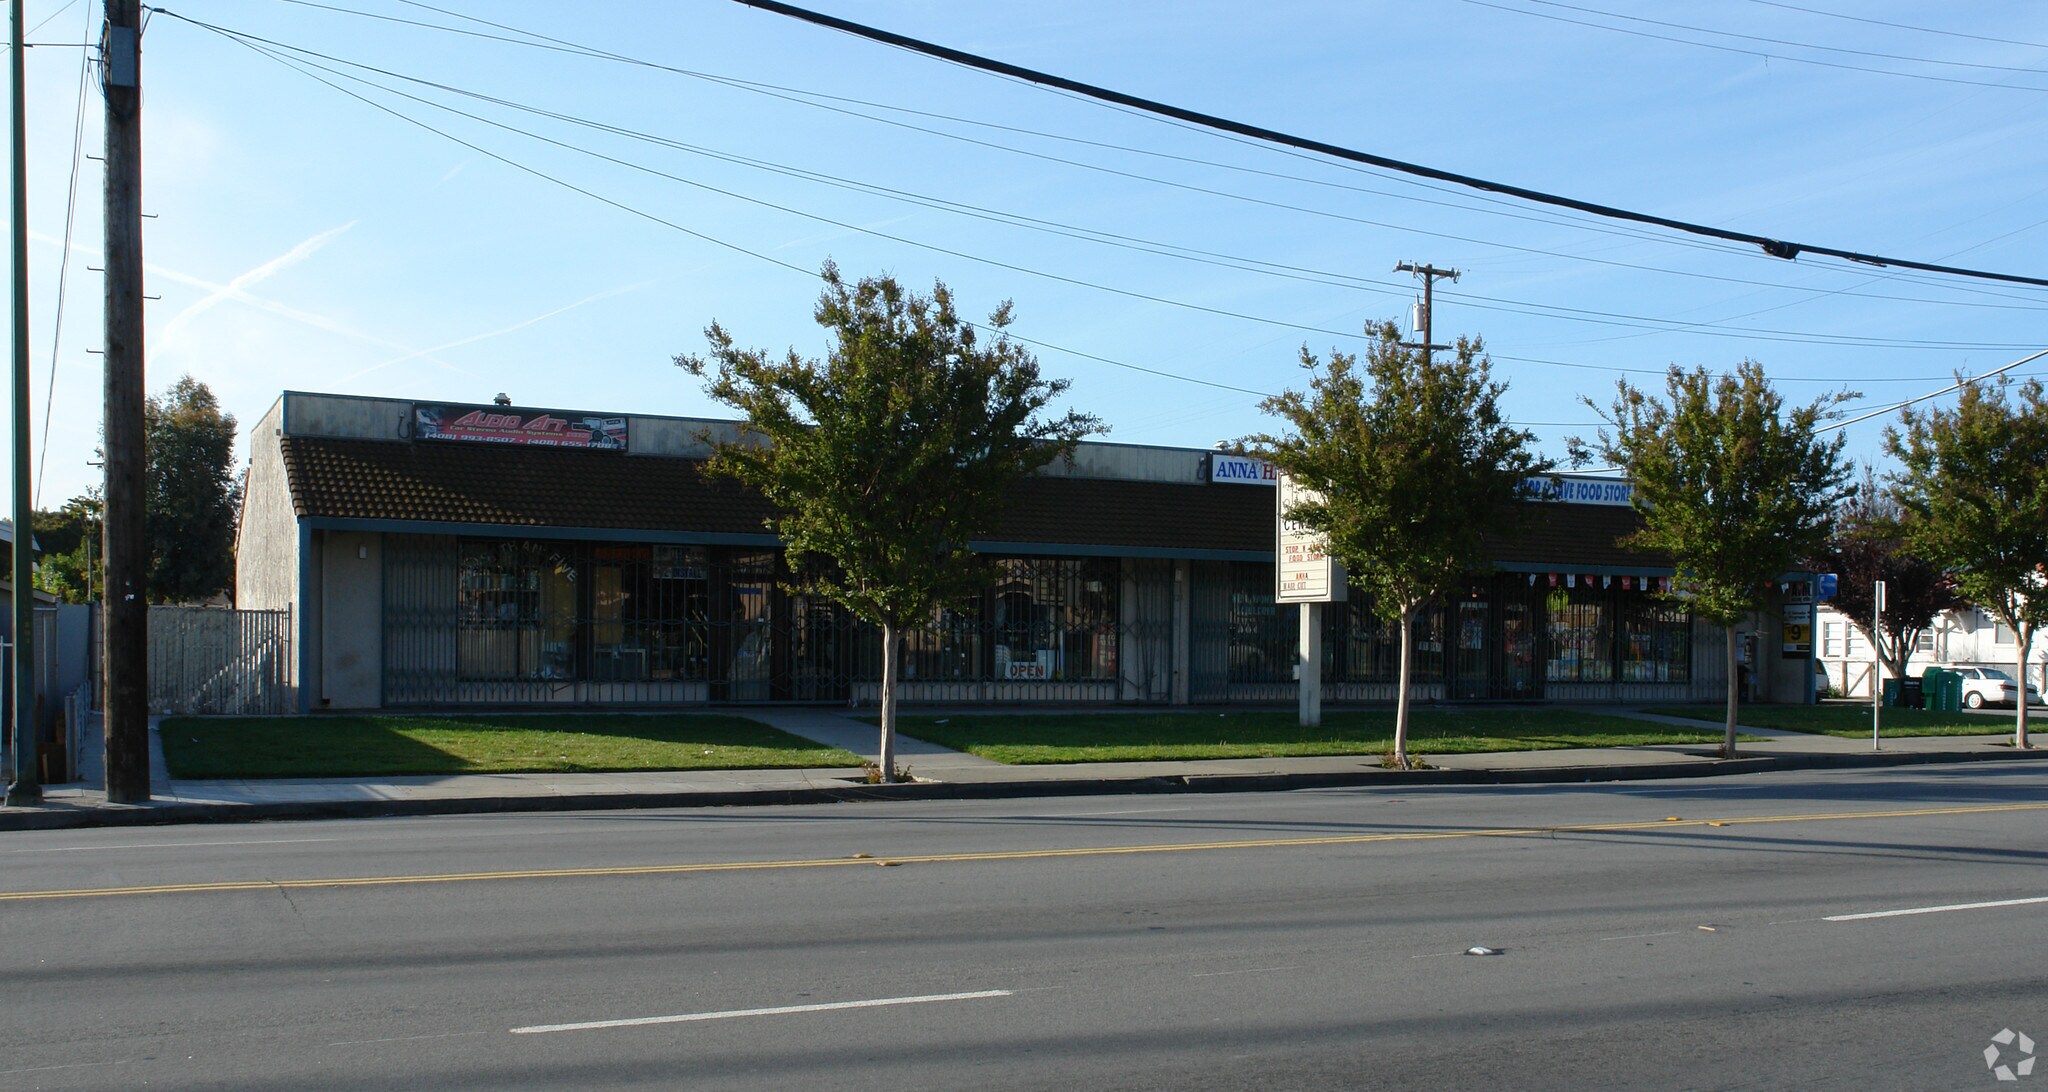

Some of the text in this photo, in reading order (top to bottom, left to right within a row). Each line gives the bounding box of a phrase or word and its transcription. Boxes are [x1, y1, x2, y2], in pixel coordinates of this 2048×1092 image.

[467, 426, 497, 434] Stereo
[499, 428, 525, 436] Audio
[527, 430, 564, 438] Systems
[425, 433, 456, 441] (408)
[527, 438, 557, 447] (408)
[1215, 461, 1258, 479] ANNA
[1576, 482, 1603, 500] FOOD
[1604, 484, 1633, 502] STORE
[1285, 545, 1299, 554] STOP
[1289, 553, 1303, 563] FOOD
[549, 552, 578, 582] FIVE
[1010, 665, 1044, 677] OPEN
